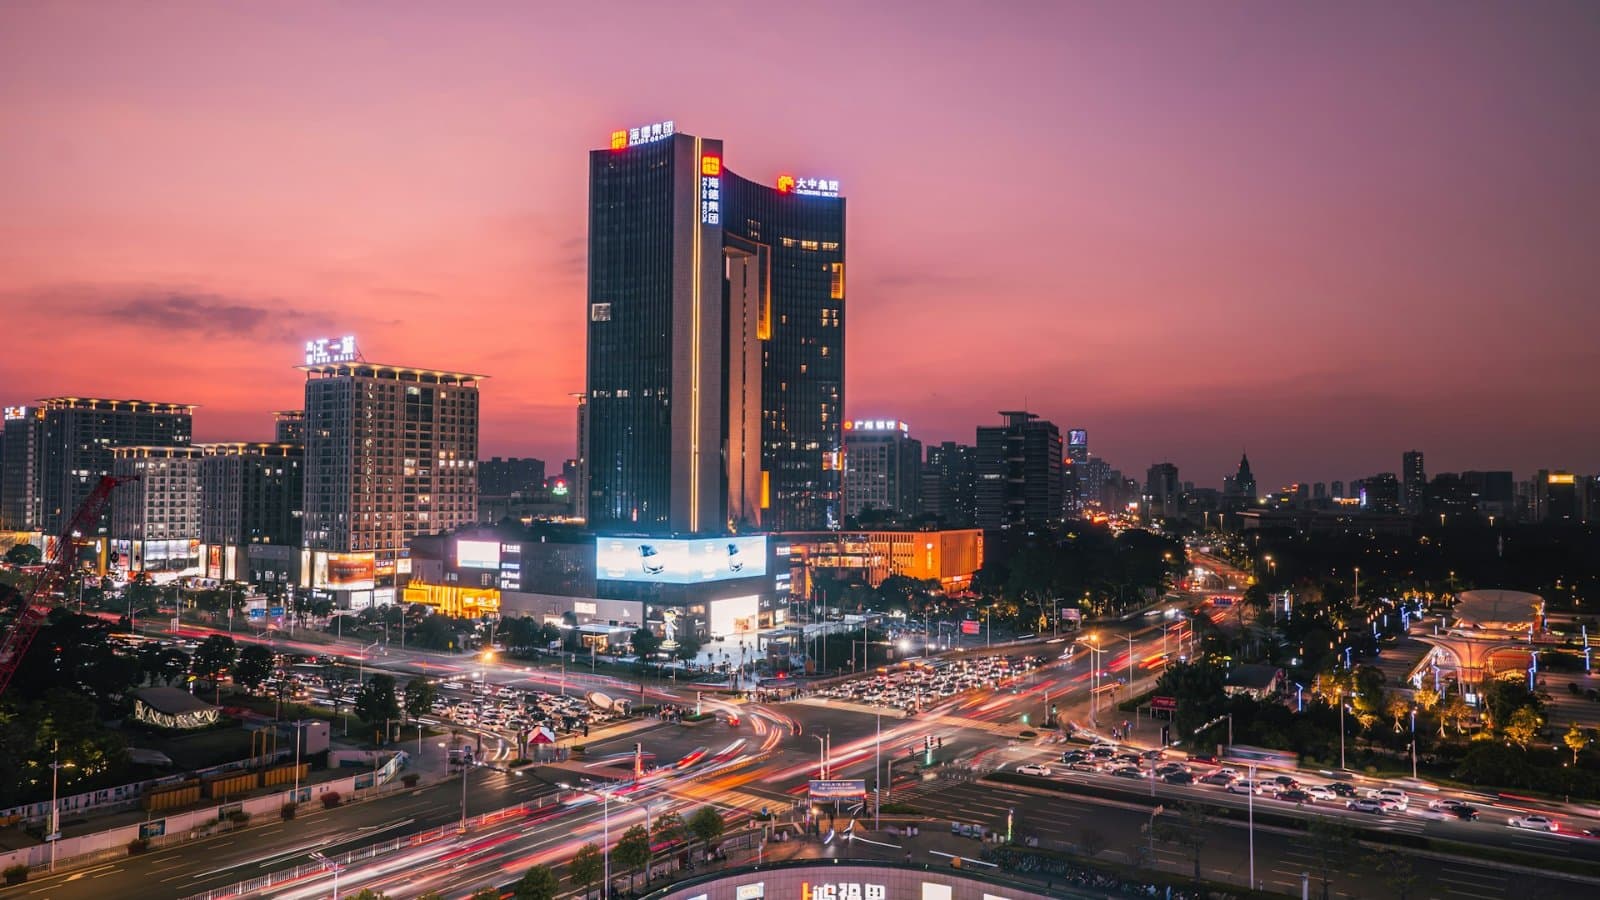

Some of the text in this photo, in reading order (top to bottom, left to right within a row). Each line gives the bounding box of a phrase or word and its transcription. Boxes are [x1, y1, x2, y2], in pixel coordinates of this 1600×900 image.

[630, 121, 673, 139] 海德集团
[796, 178, 838, 191] 大中集团
[708, 177, 719, 224] 海德集团
